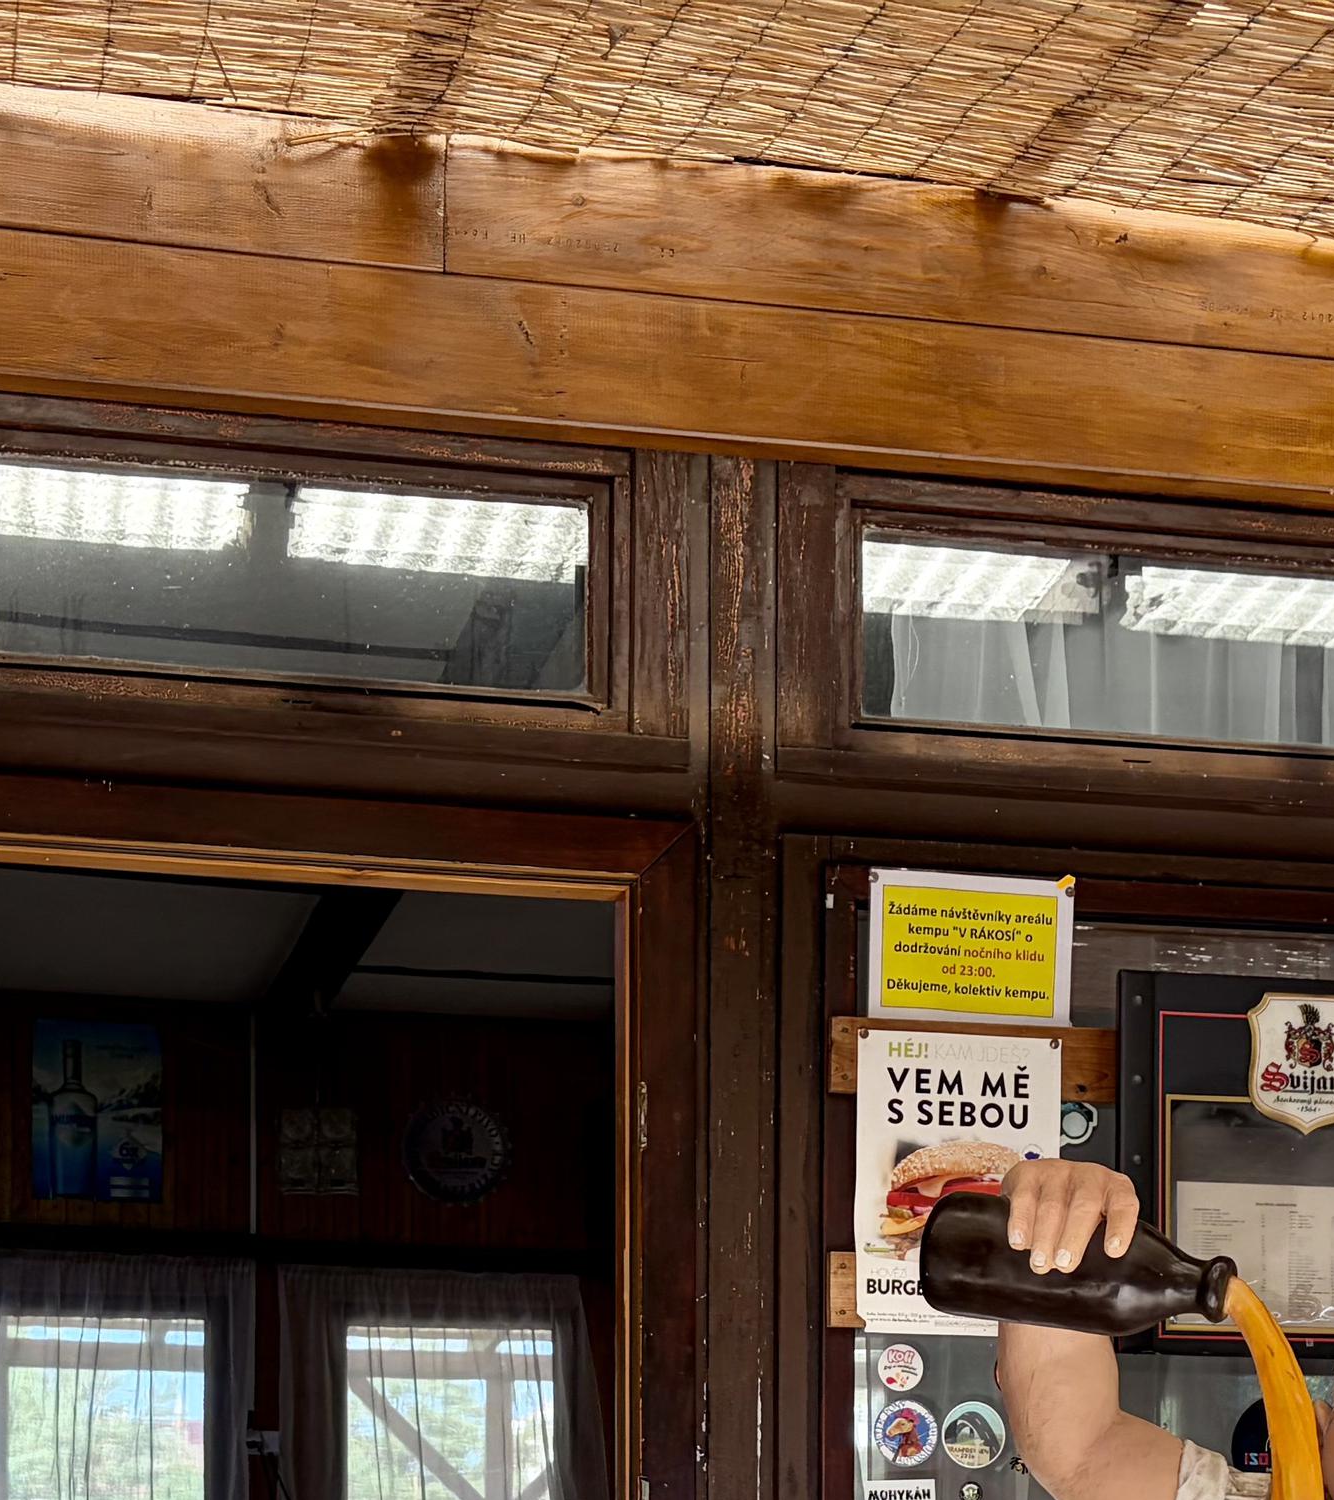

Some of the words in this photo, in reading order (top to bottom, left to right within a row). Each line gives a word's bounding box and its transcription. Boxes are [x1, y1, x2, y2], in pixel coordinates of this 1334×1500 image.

[888, 901, 937, 917] Žádáme
[941, 907, 1011, 924] návštěvníky
[1015, 912, 1053, 925] areálu
[908, 923, 949, 938] kempu
[1025, 934, 1033, 942] o
[894, 941, 961, 956] dodržování
[964, 947, 1011, 960] nočního
[1015, 949, 1044, 962] klidu
[942, 964, 956, 974] od
[960, 965, 995, 978] 23:00.
[887, 978, 951, 995] Děkujeme,
[954, 982, 1001, 997] kolektiv
[1005, 985, 1049, 1001] kempu.
[888, 1038, 929, 1058] HÉJ!
[887, 1067, 964, 1096] VEM
[980, 1065, 1030, 1099] MĚ
[887, 1098, 904, 1125] S
[917, 1099, 1029, 1130] SEBOU
[867, 1279, 924, 1296] BURGE
